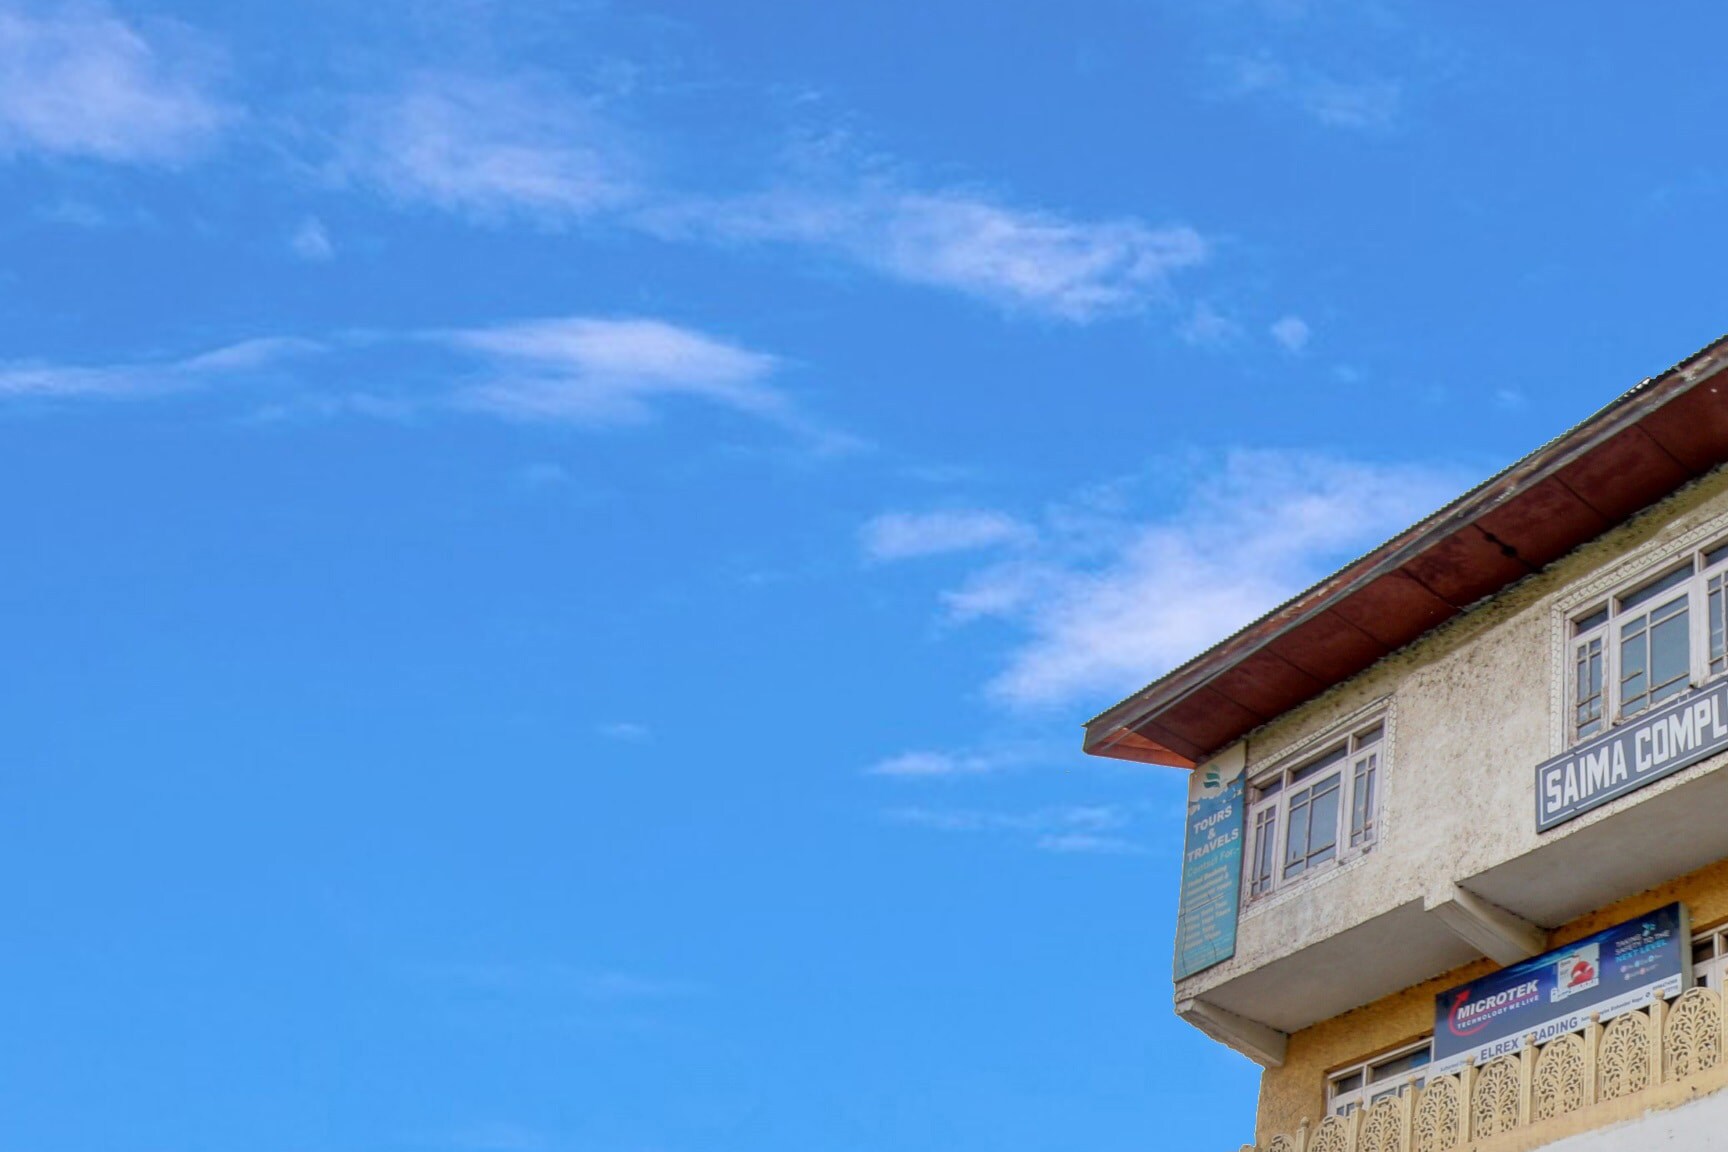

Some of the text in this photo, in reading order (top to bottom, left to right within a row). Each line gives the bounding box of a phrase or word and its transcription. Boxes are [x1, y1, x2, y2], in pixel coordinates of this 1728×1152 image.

[1546, 740, 1628, 814] SAIMA
[1193, 805, 1232, 834] TOURS
[1208, 828, 1216, 840] &
[1187, 828, 1239, 862] TRAVELS
[1457, 980, 1539, 1020] MICROTEK
[1457, 1008, 1507, 1029] TECHNOLOGY
[1522, 995, 1539, 1006] LIVE
[1480, 1038, 1519, 1060] ELREX
